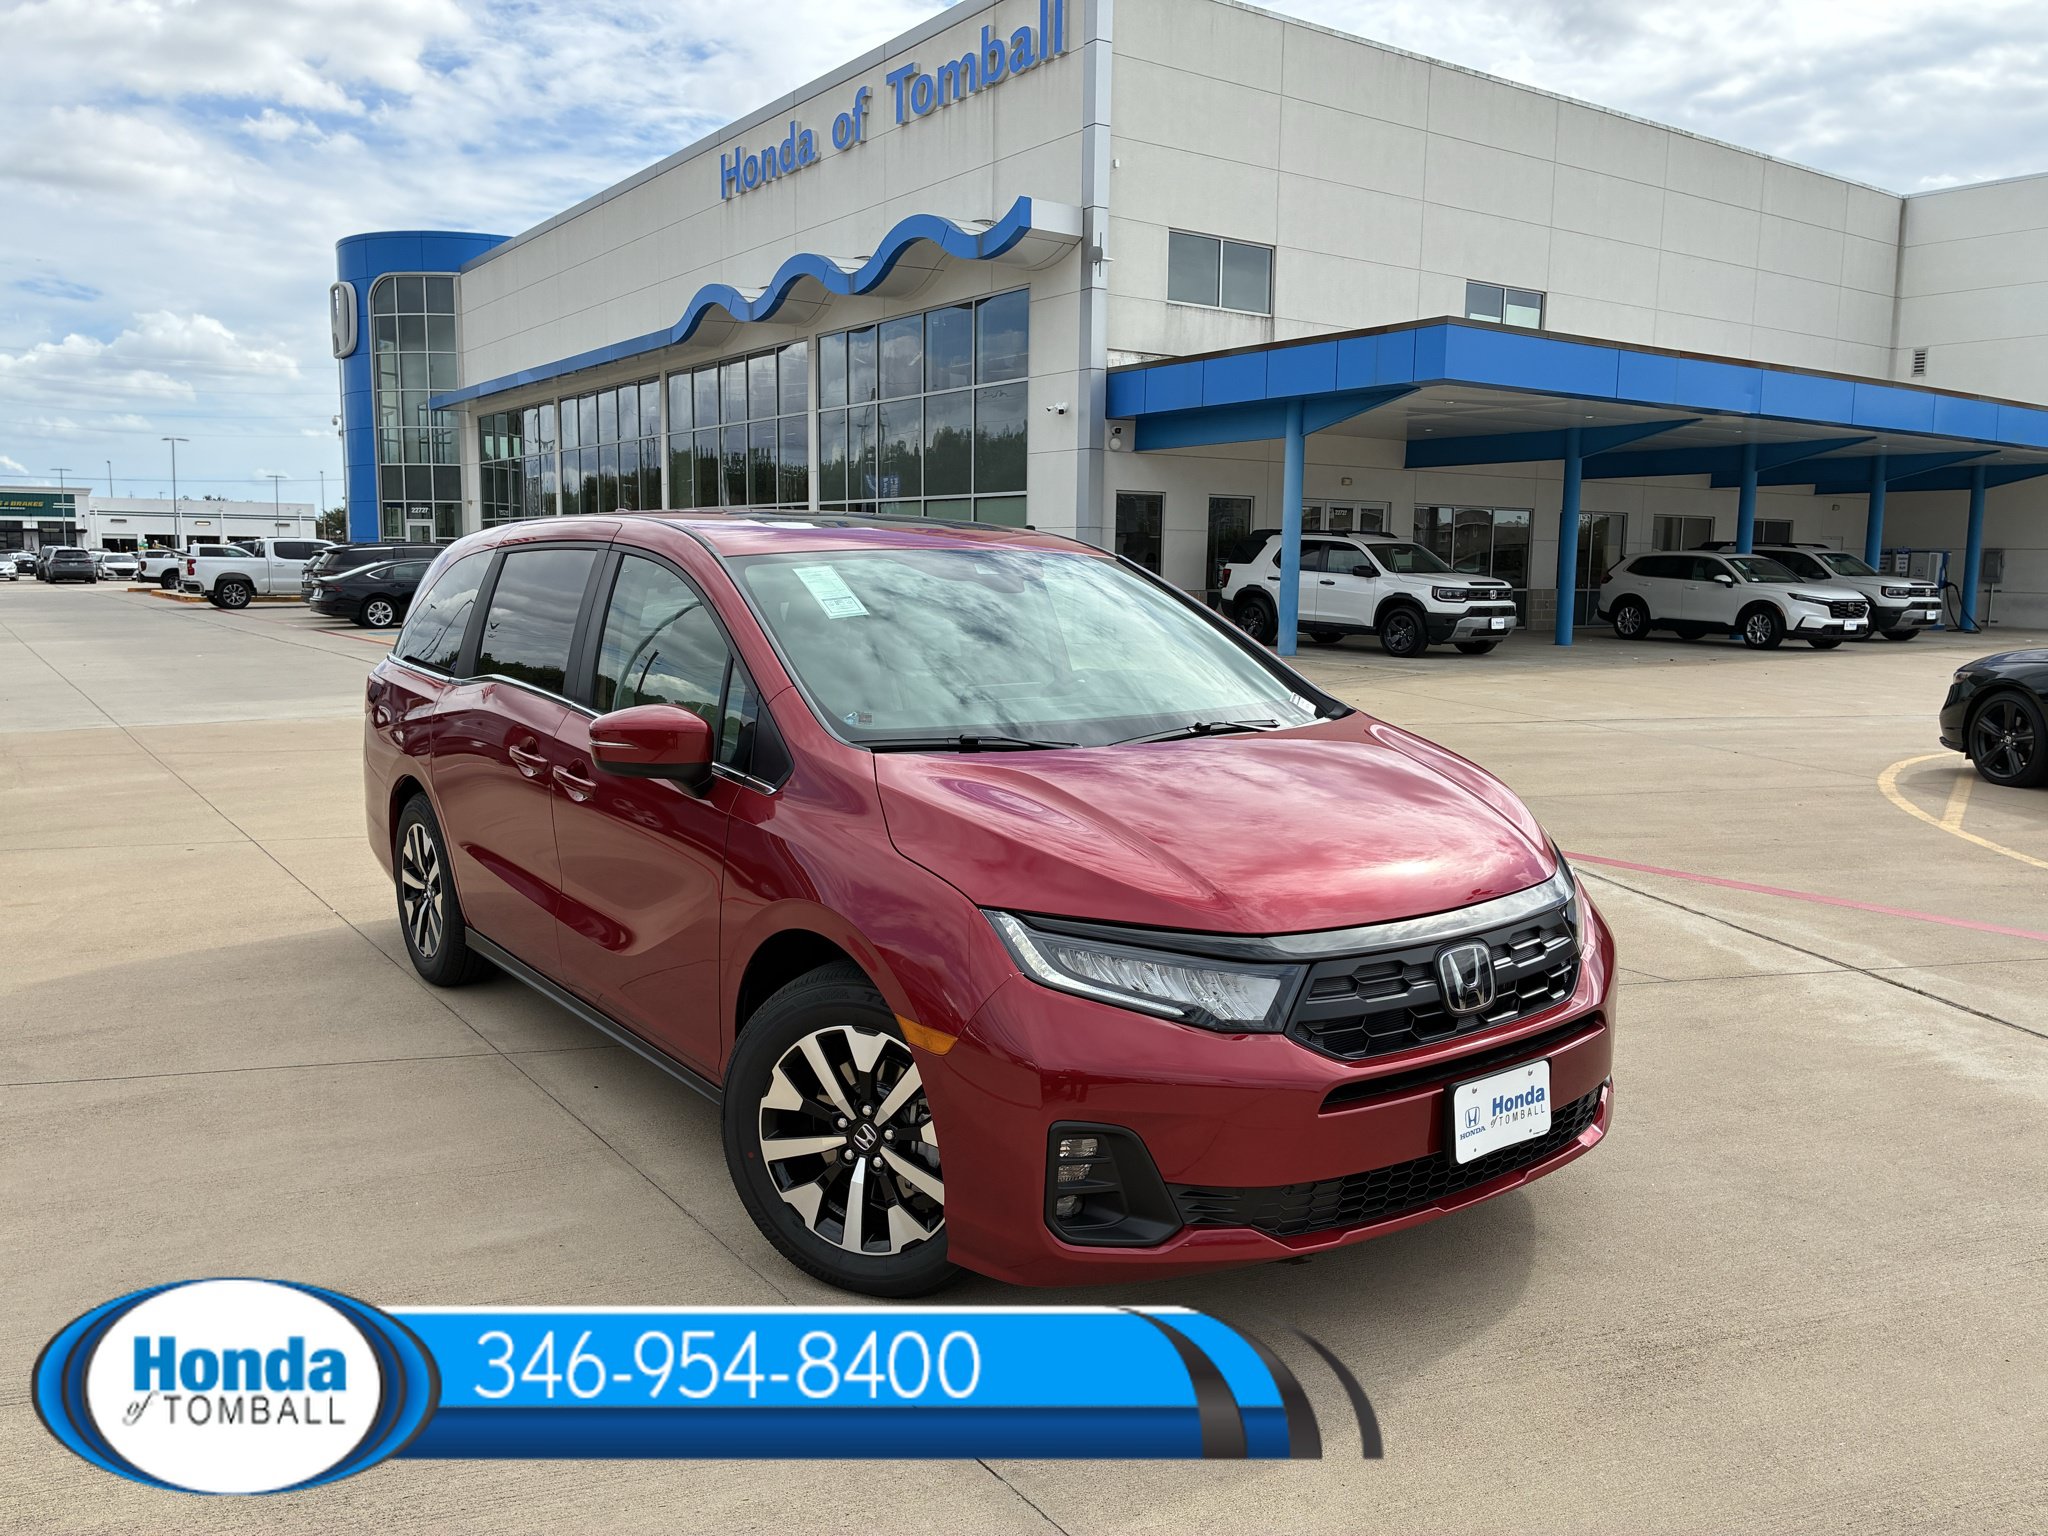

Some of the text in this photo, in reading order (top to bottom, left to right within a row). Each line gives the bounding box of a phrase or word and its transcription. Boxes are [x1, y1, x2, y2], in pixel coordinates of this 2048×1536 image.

[720, 0, 1066, 199] Honda of Tomball
[1492, 1085, 1545, 1116] Honda
[1499, 1104, 1545, 1126] TOMBALL
[1460, 1125, 1486, 1140] HONDA
